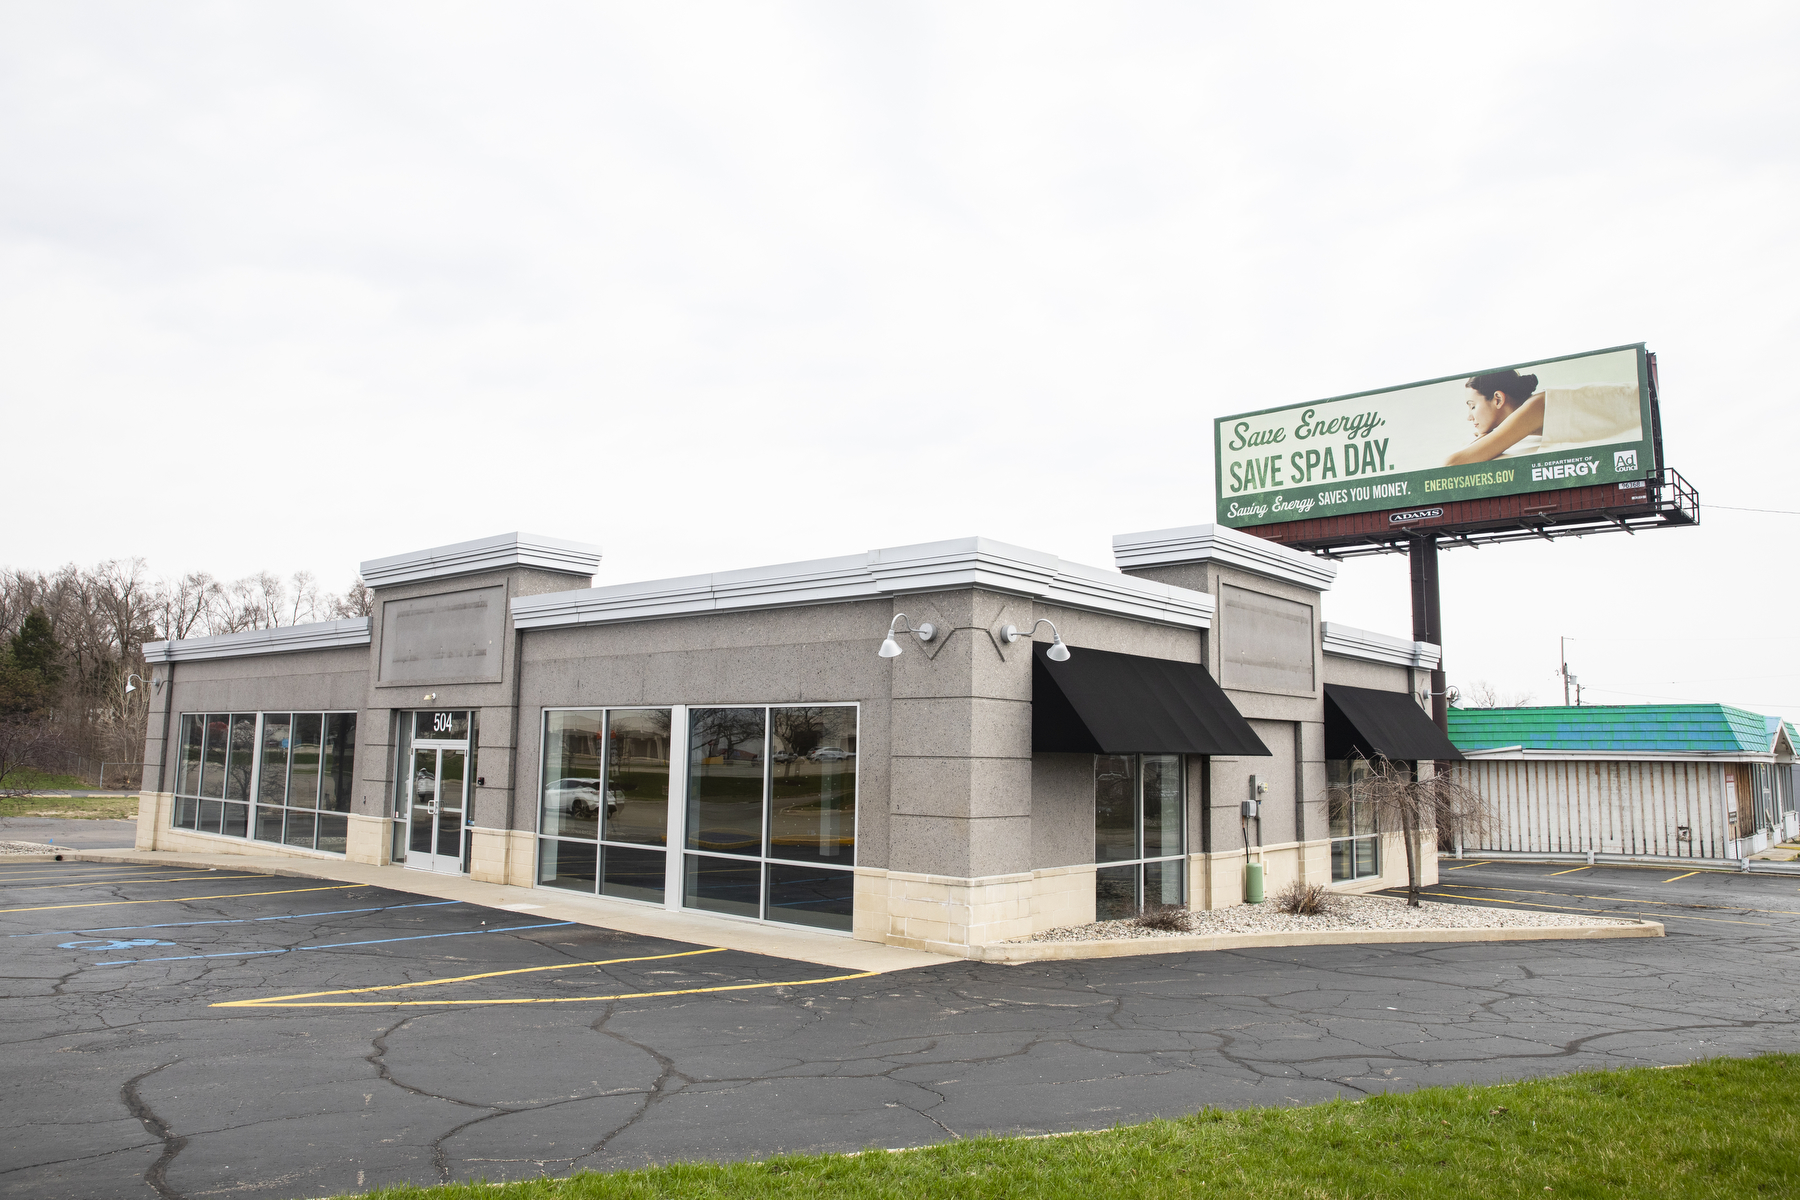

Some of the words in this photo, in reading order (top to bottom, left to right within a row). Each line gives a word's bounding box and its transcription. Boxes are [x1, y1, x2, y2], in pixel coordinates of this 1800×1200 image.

[1229, 421, 1286, 451] Save
[1294, 409, 1386, 440] Energy.
[1229, 454, 1284, 493] SAVE
[1290, 446, 1338, 484] SPA
[1344, 437, 1395, 477] DAY.
[1531, 460, 1600, 482] ENERGY
[1544, 457, 1583, 467] DEPARTMENT
[1616, 454, 1637, 467] Ad
[1424, 469, 1515, 493] ENERGYSAVERS.GOV
[1227, 502, 1269, 518] Saving
[1272, 495, 1316, 513] Energy
[1318, 489, 1348, 506] SAVES
[1350, 486, 1370, 502] YOU
[1372, 481, 1411, 499] MONEY.
[1393, 509, 1440, 521] ADAMS
[433, 712, 453, 732] 504
